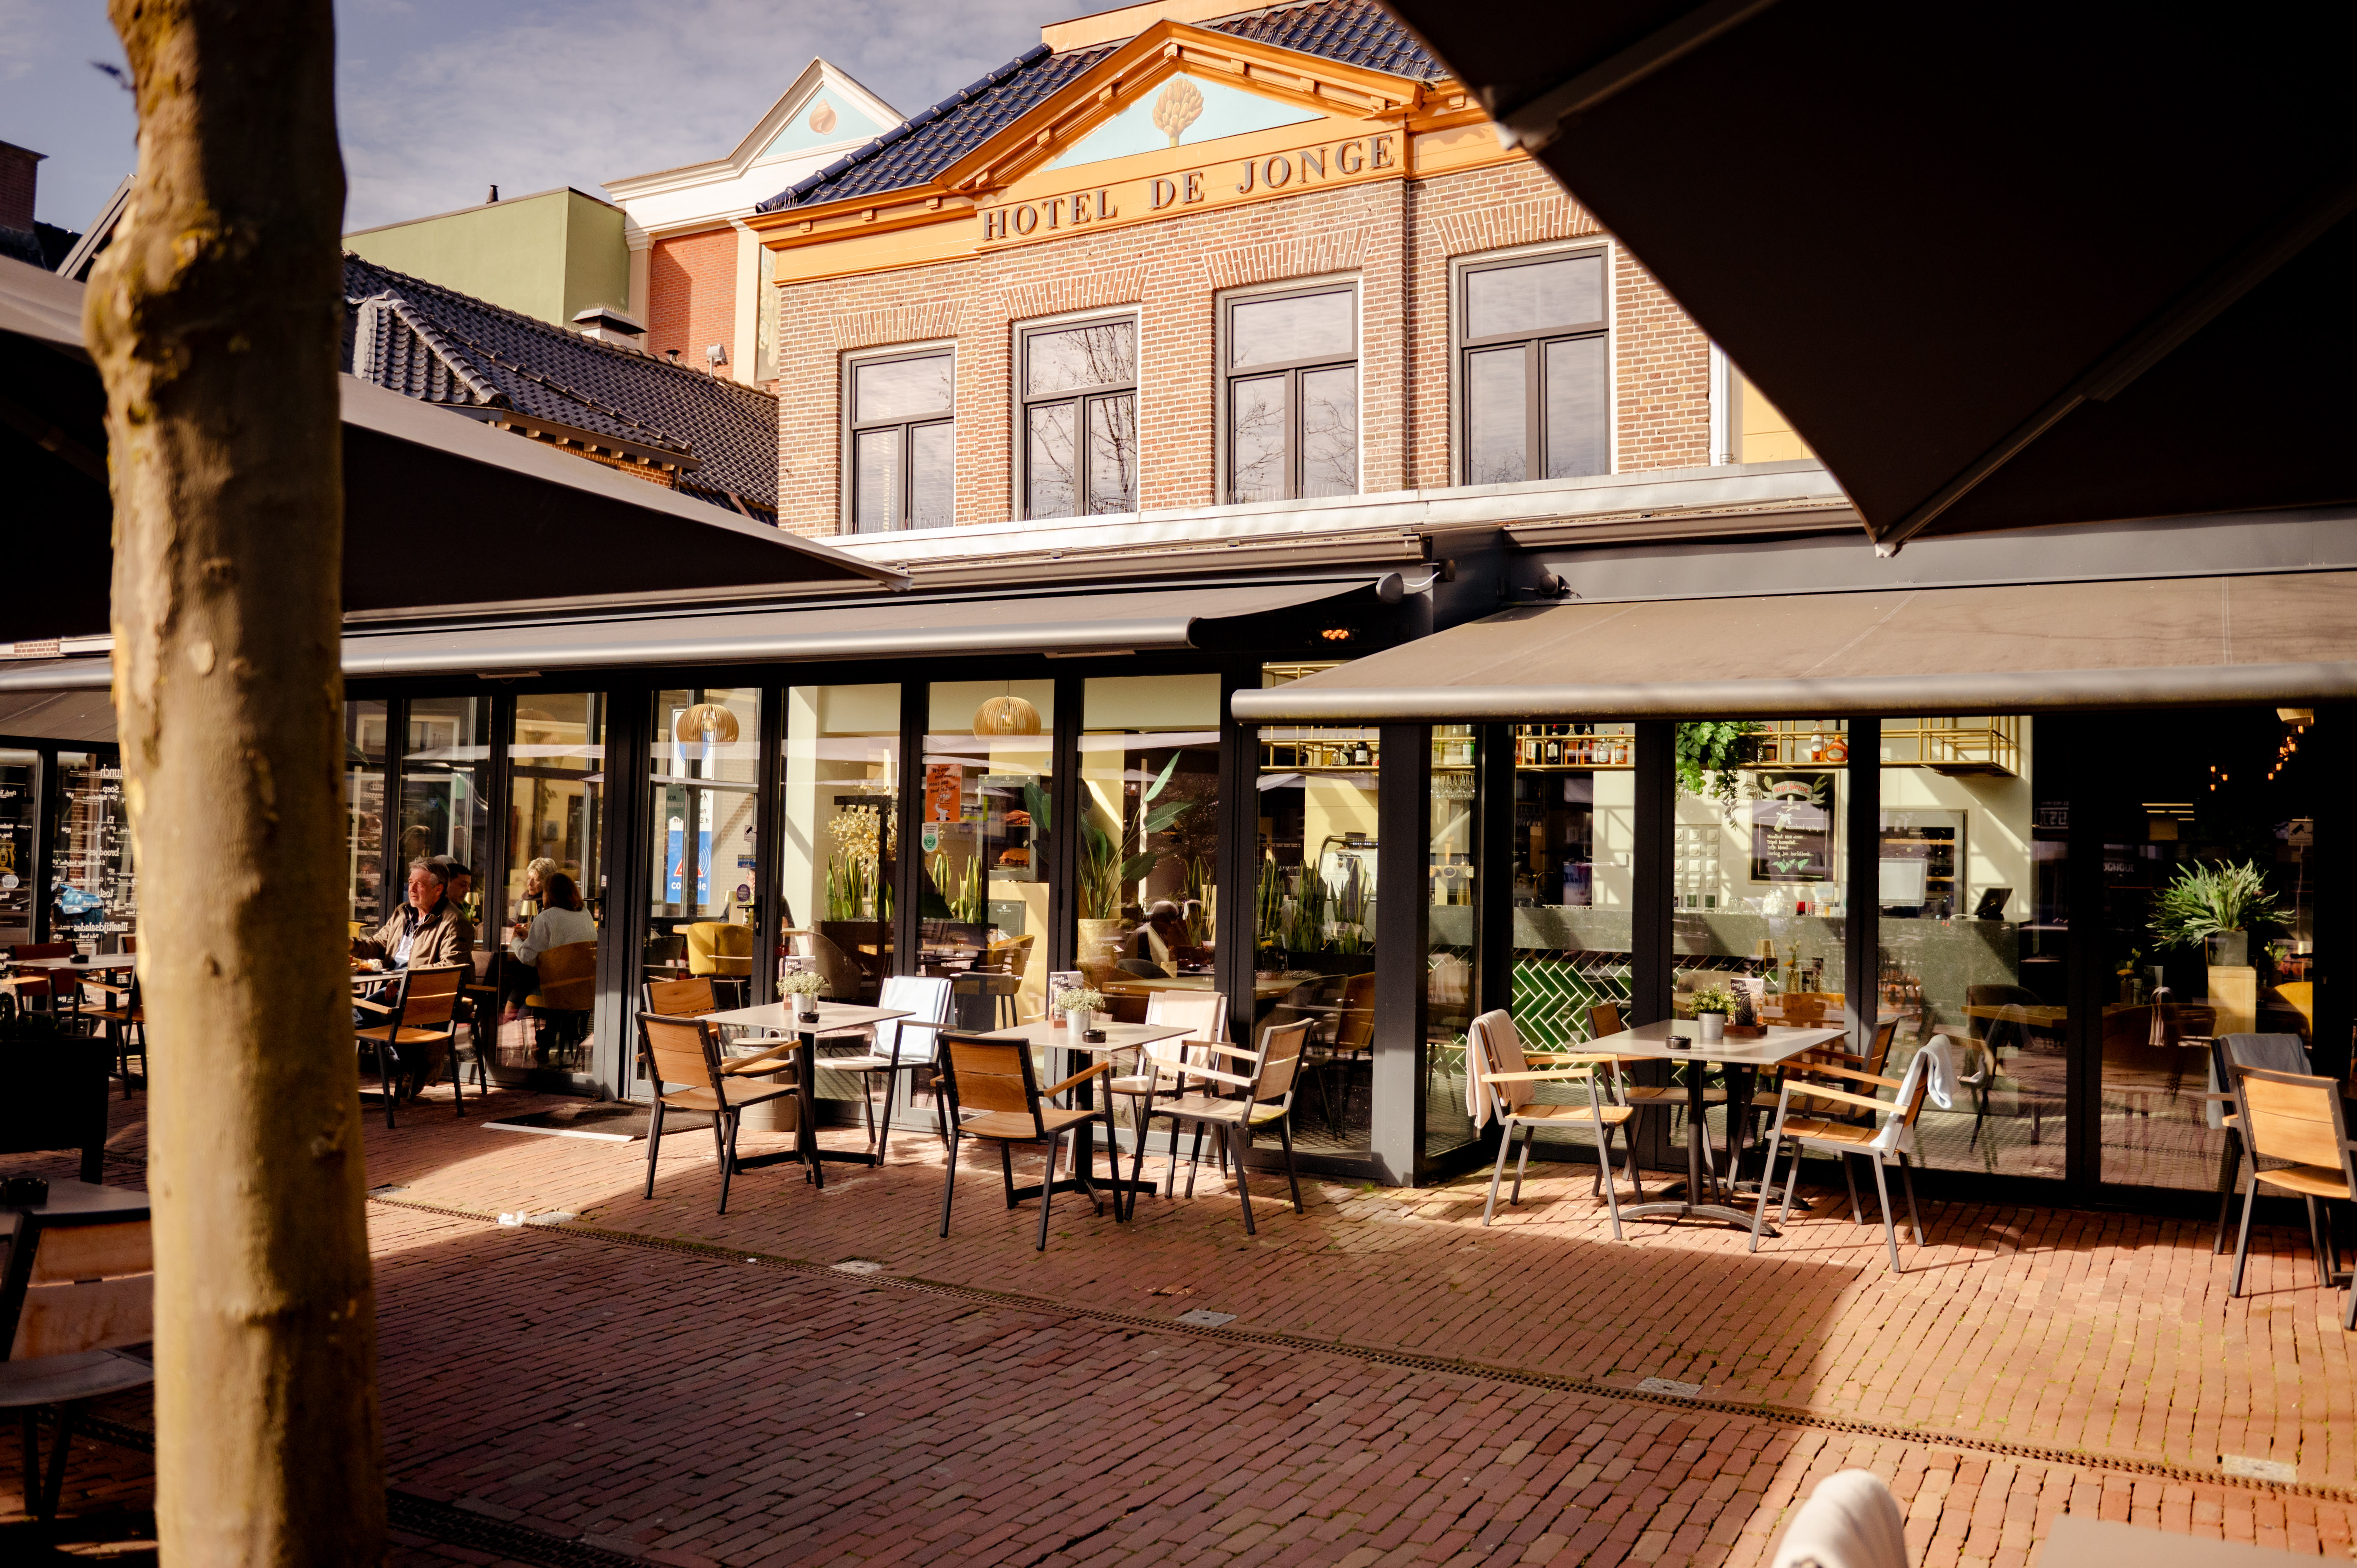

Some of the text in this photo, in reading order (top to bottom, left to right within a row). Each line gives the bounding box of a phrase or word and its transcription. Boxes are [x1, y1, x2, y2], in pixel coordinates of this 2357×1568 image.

[981, 134, 1394, 242] HOTEL DE JONGE
[1774, 781, 1809, 793] onze bieren
